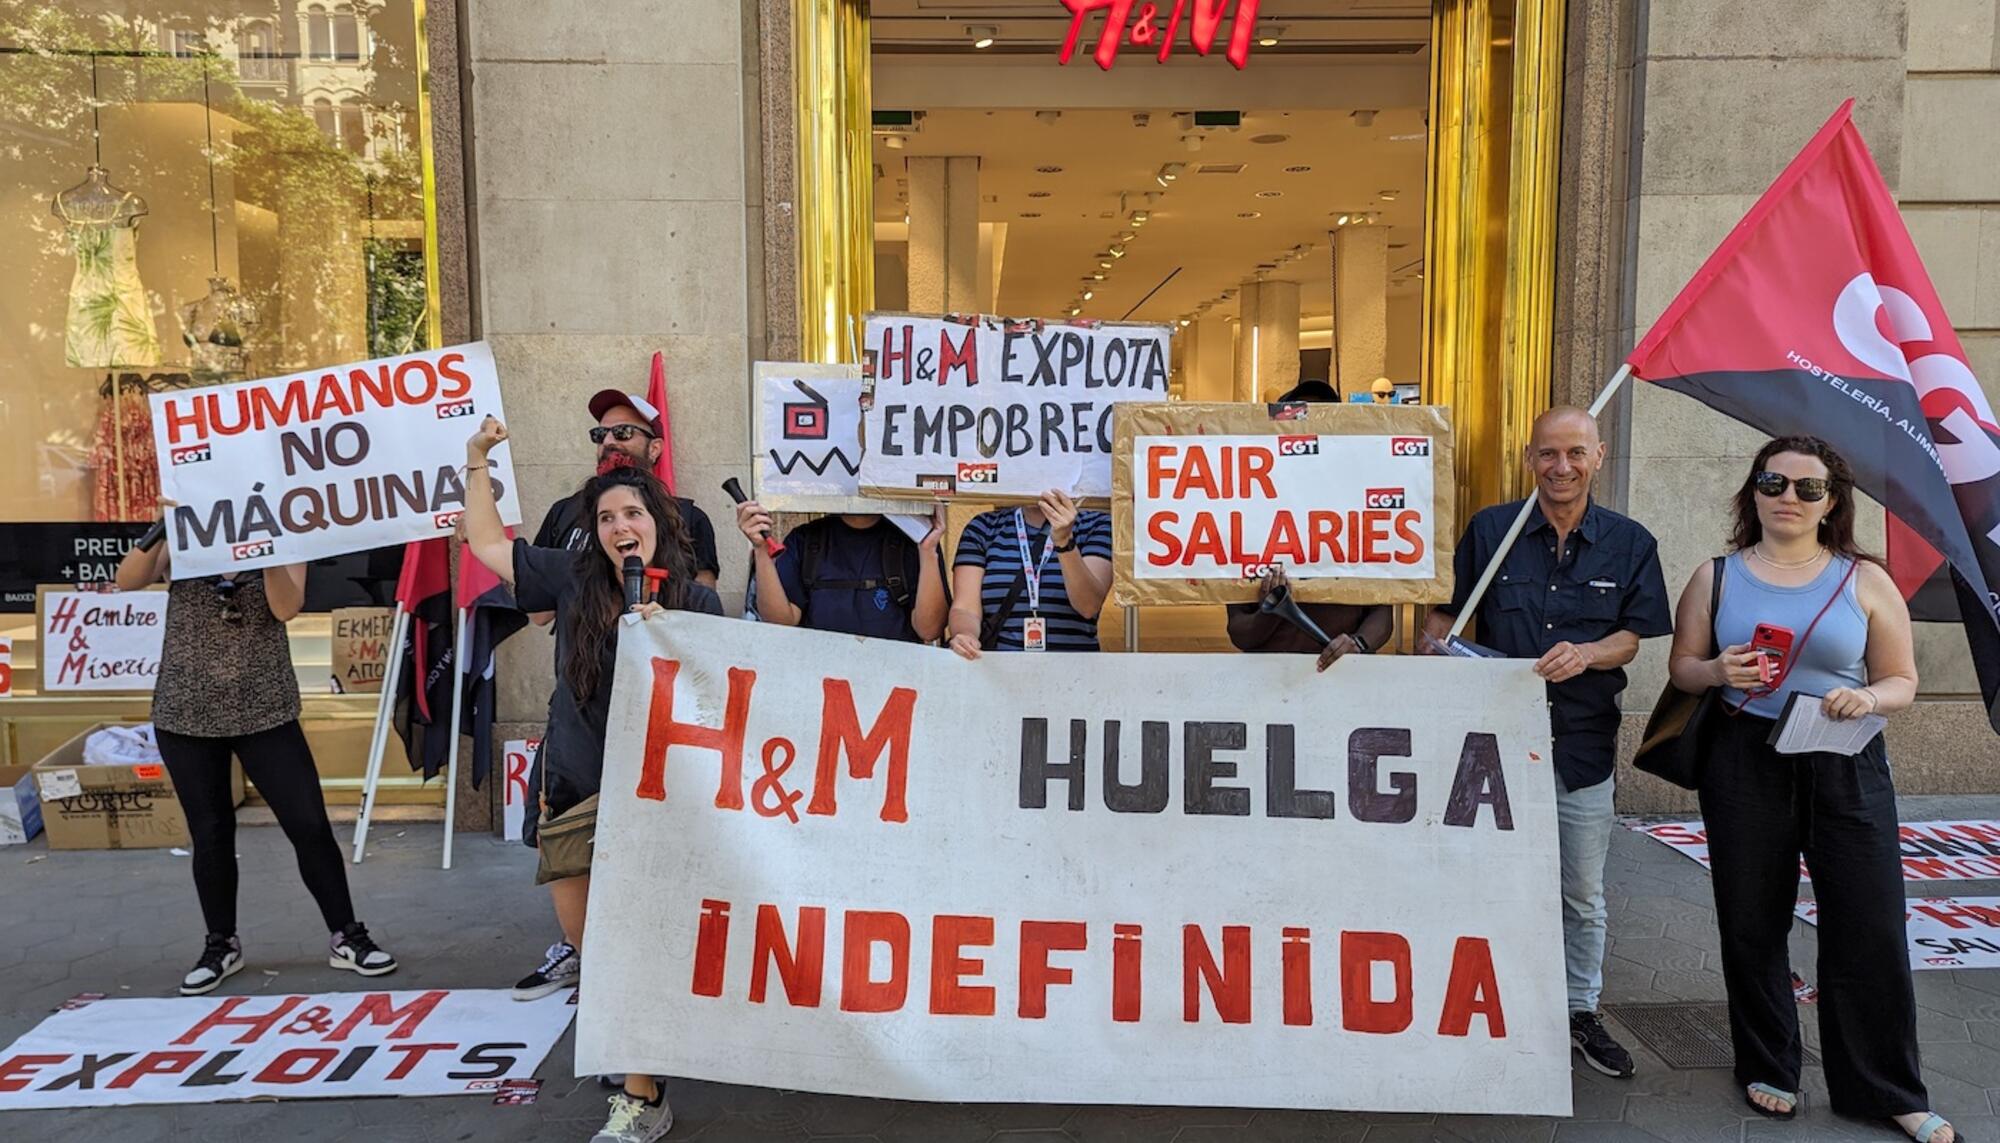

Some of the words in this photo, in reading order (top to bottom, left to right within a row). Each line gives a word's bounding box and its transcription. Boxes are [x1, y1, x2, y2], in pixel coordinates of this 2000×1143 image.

[881, 325, 979, 386] H&M
[1002, 331, 1168, 392] EXPLOTA
[164, 353, 472, 444] HUMANOS
[438, 402, 475, 418] CGT
[1786, 350, 1894, 422] HOSTELERÍA,
[1833, 272, 2000, 548] CG
[280, 421, 371, 476] NO
[881, 401, 1114, 458] EMPOBREC
[1280, 441, 1318, 455] CGT
[1393, 442, 1429, 455] CGT
[172, 449, 210, 465] CGT
[959, 468, 997, 482] CGT
[1147, 445, 1278, 500] FAIR
[1368, 492, 1404, 507] CGT
[234, 543, 273, 560] CGT
[1148, 510, 1425, 566] SALARIES
[79, 563, 121, 581] BAI
[68, 626, 91, 652] &
[635, 656, 918, 824] H&M
[1018, 716, 1514, 831] HUELGA
[168, 990, 450, 1046] H&M
[0, 1042, 528, 1092] EXPLOITS
